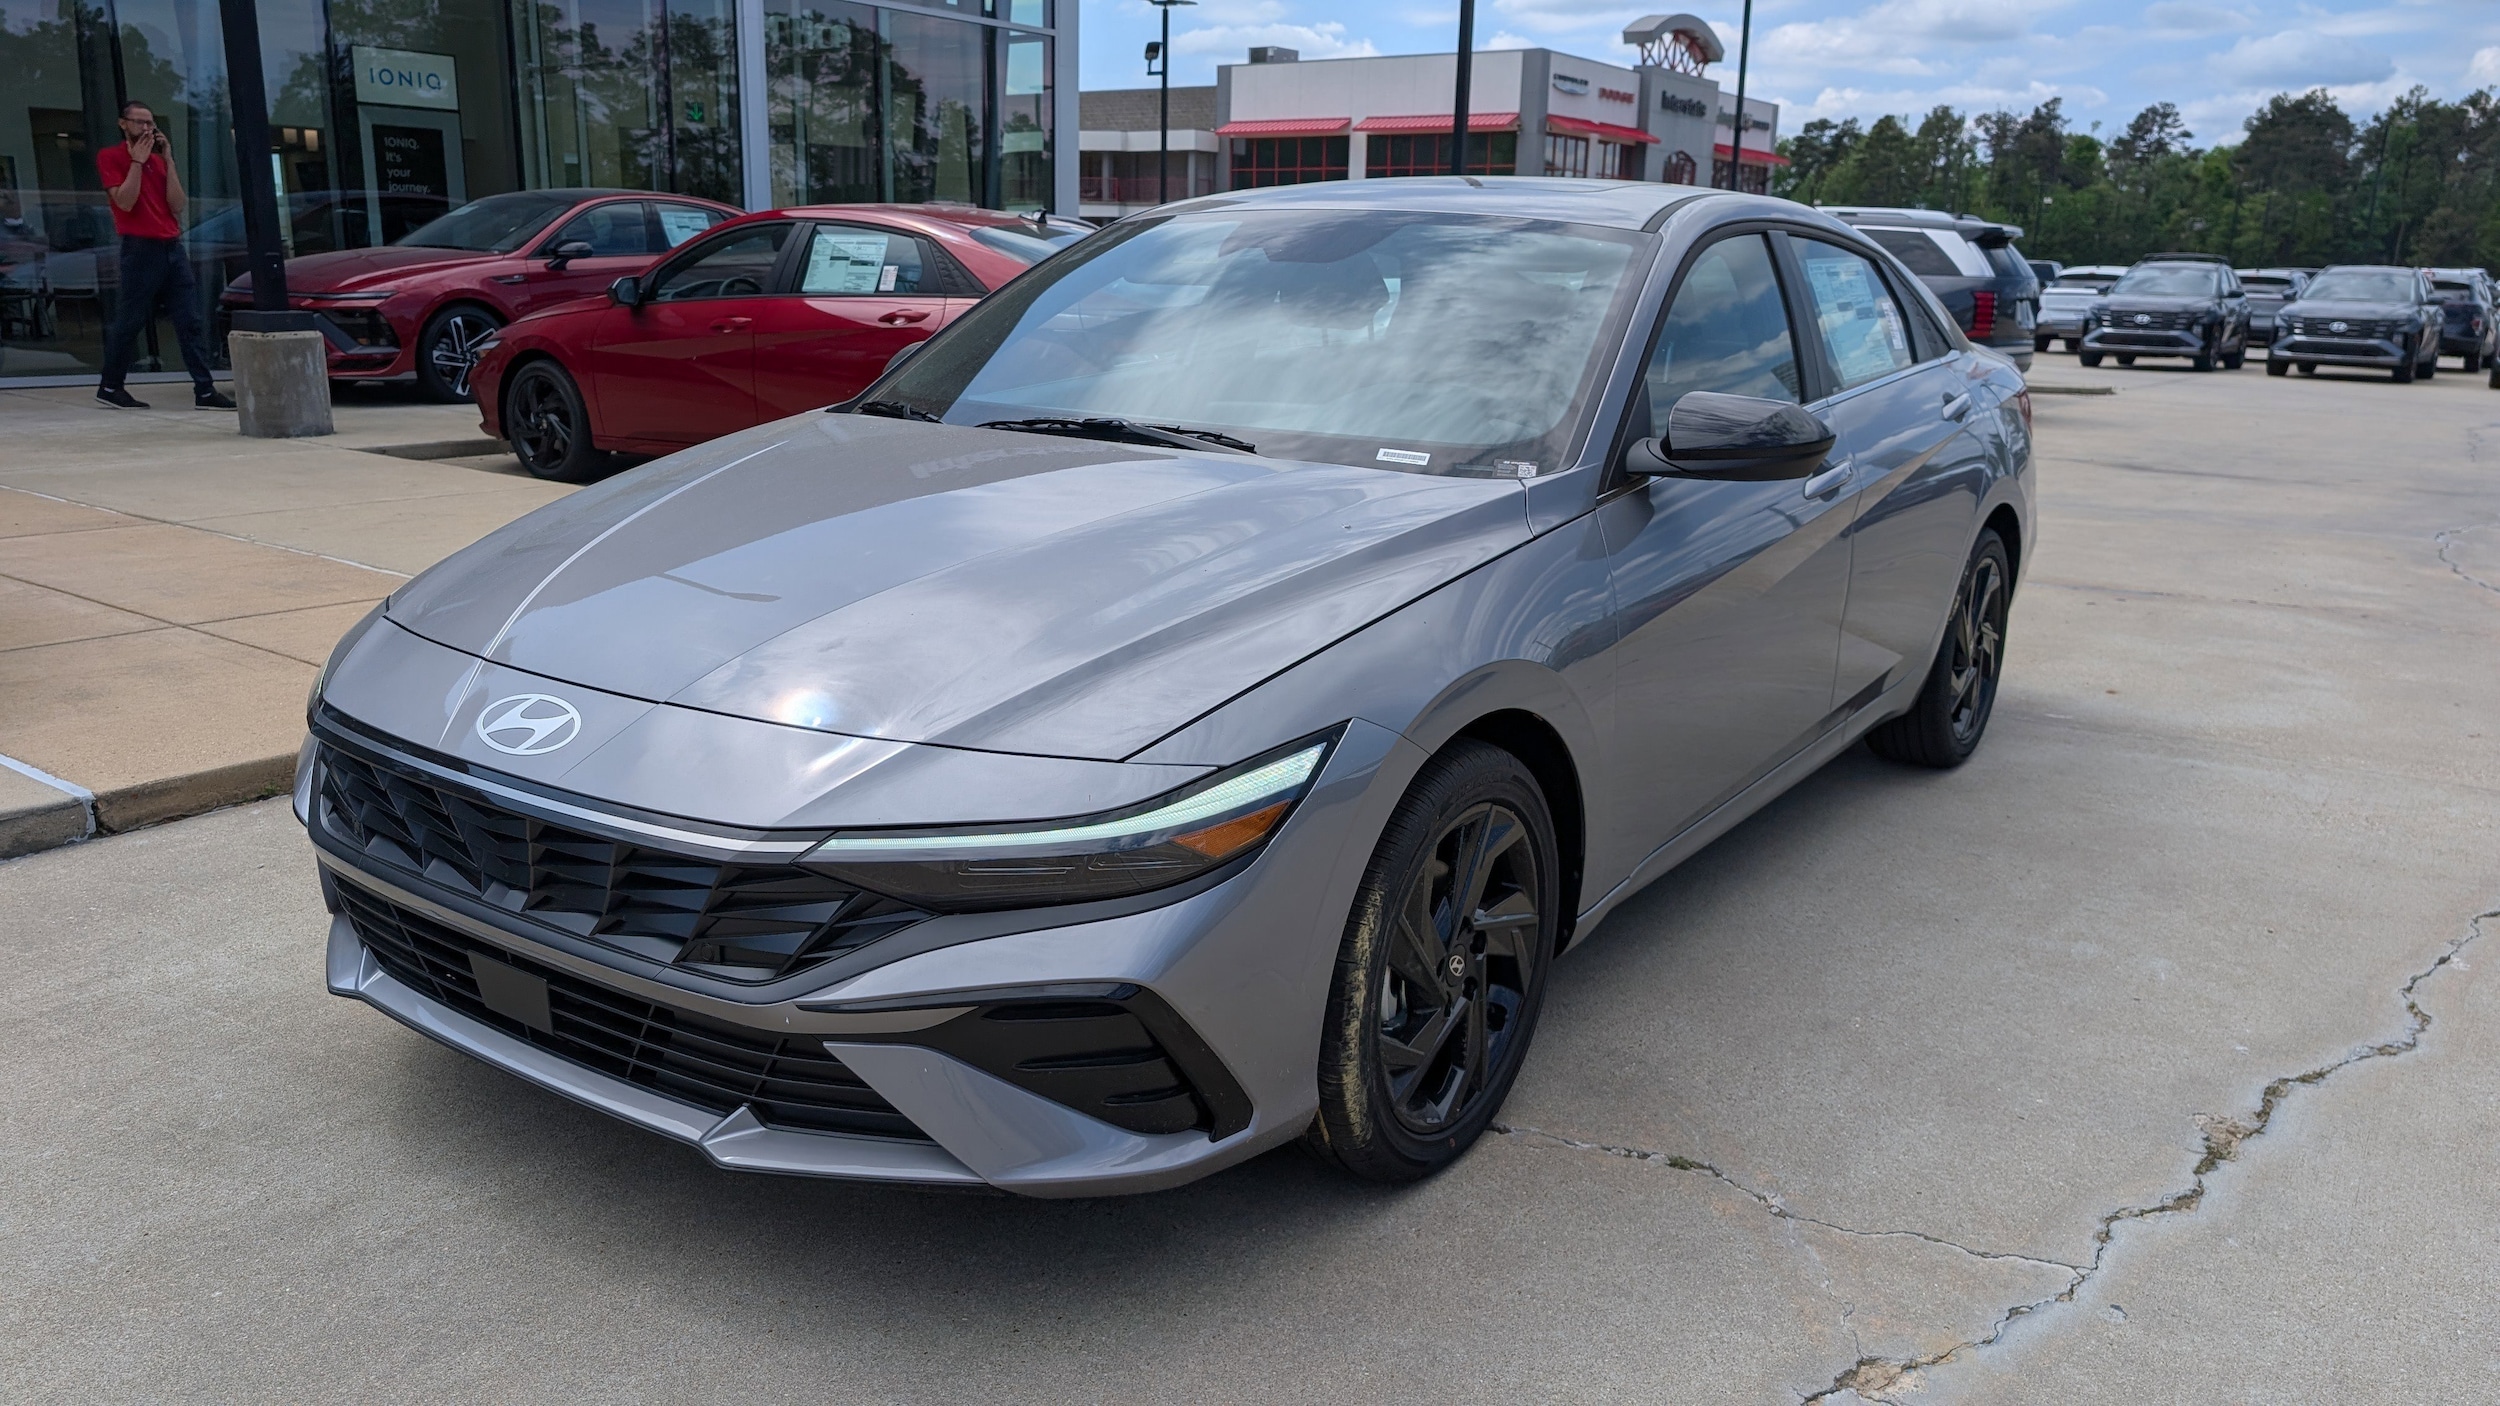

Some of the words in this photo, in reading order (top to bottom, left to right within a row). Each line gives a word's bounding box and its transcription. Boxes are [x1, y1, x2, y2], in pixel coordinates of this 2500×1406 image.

[369, 68, 442, 90] IONIQ
[384, 137, 420, 149] IONIQ.
[387, 168, 411, 179] your
